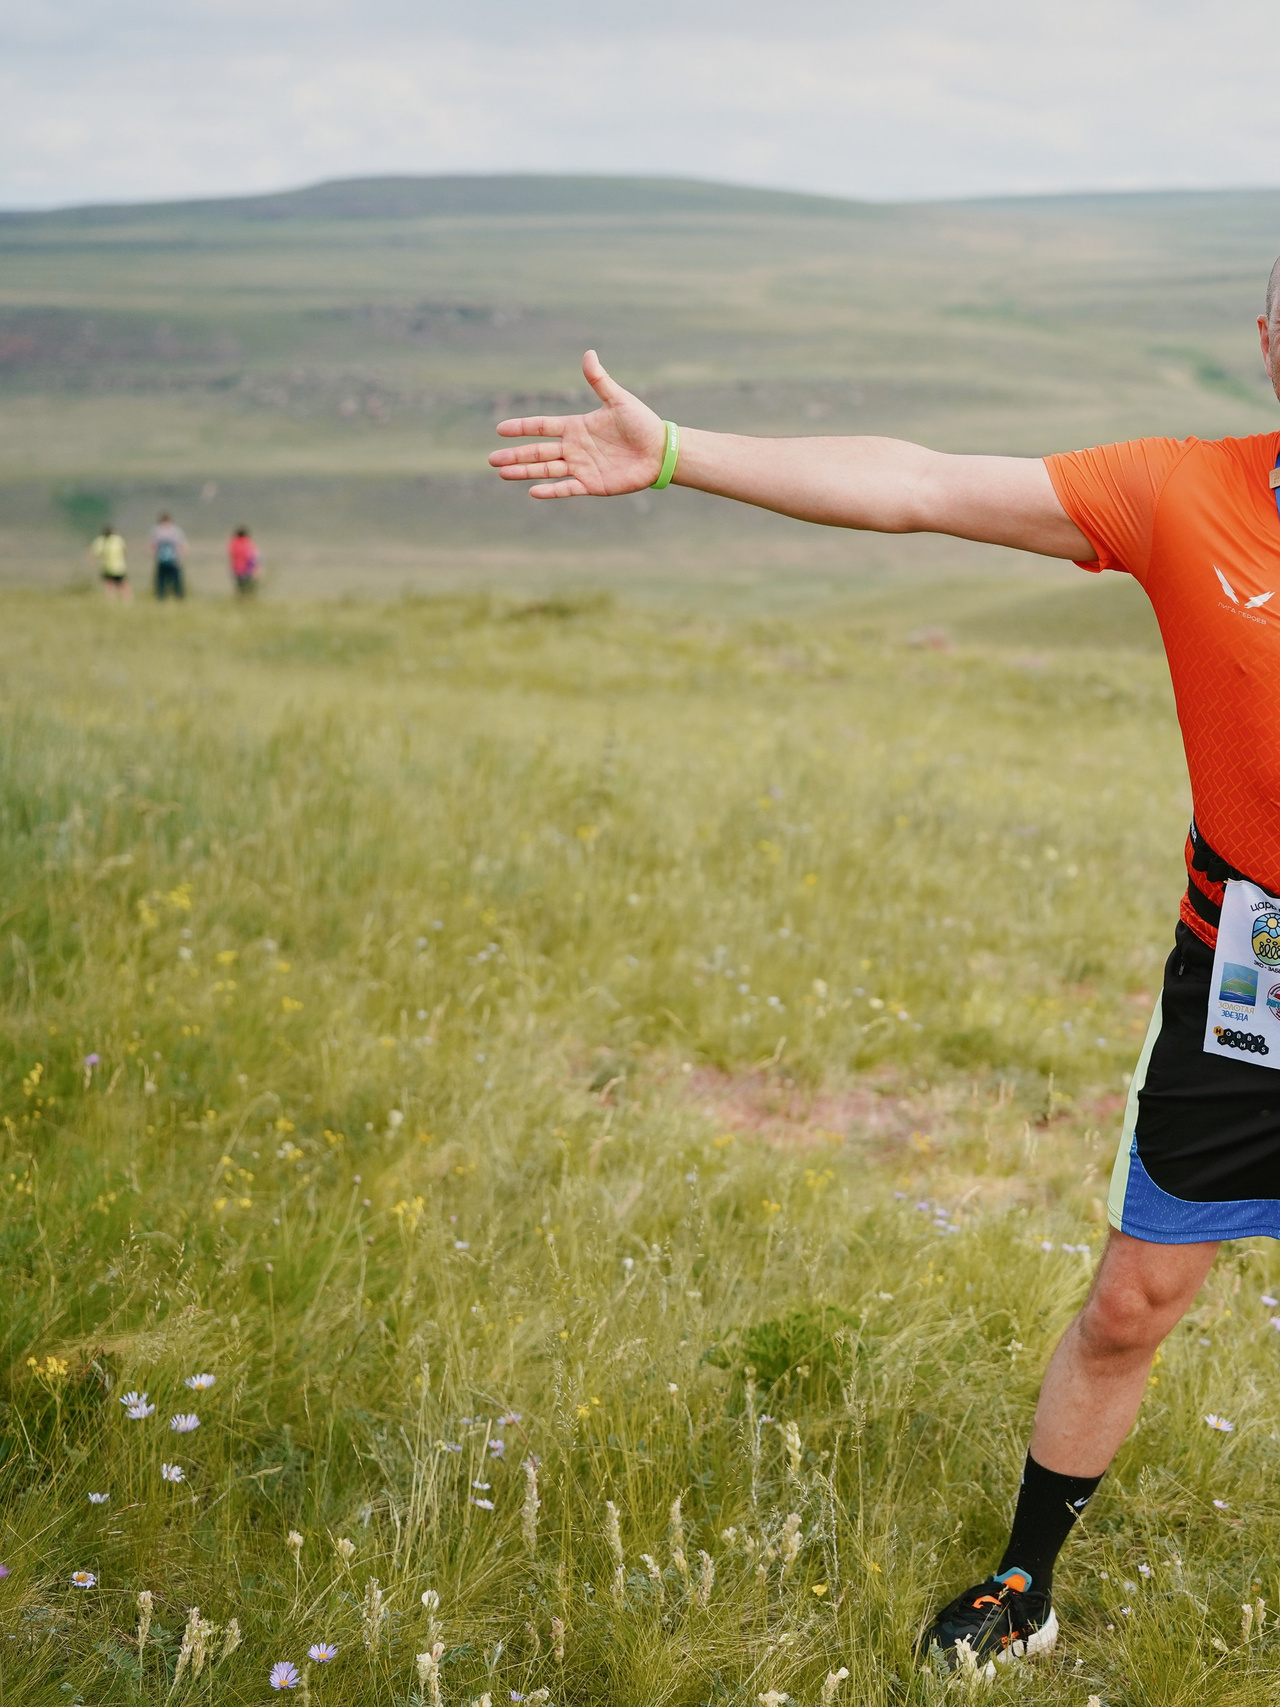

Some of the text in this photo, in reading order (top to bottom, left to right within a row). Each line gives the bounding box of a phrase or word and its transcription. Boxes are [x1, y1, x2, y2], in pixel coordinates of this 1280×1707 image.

[1217, 602, 1267, 625] ЛИГА ГЕРОЕВ
[1218, 1001, 1255, 1014] ЗОЛОТАЯ
[1221, 1009, 1249, 1022] ЗВЕЗДА
[1215, 1028, 1262, 1043] HOBBY
[1220, 1037, 1266, 1053] GAMES
